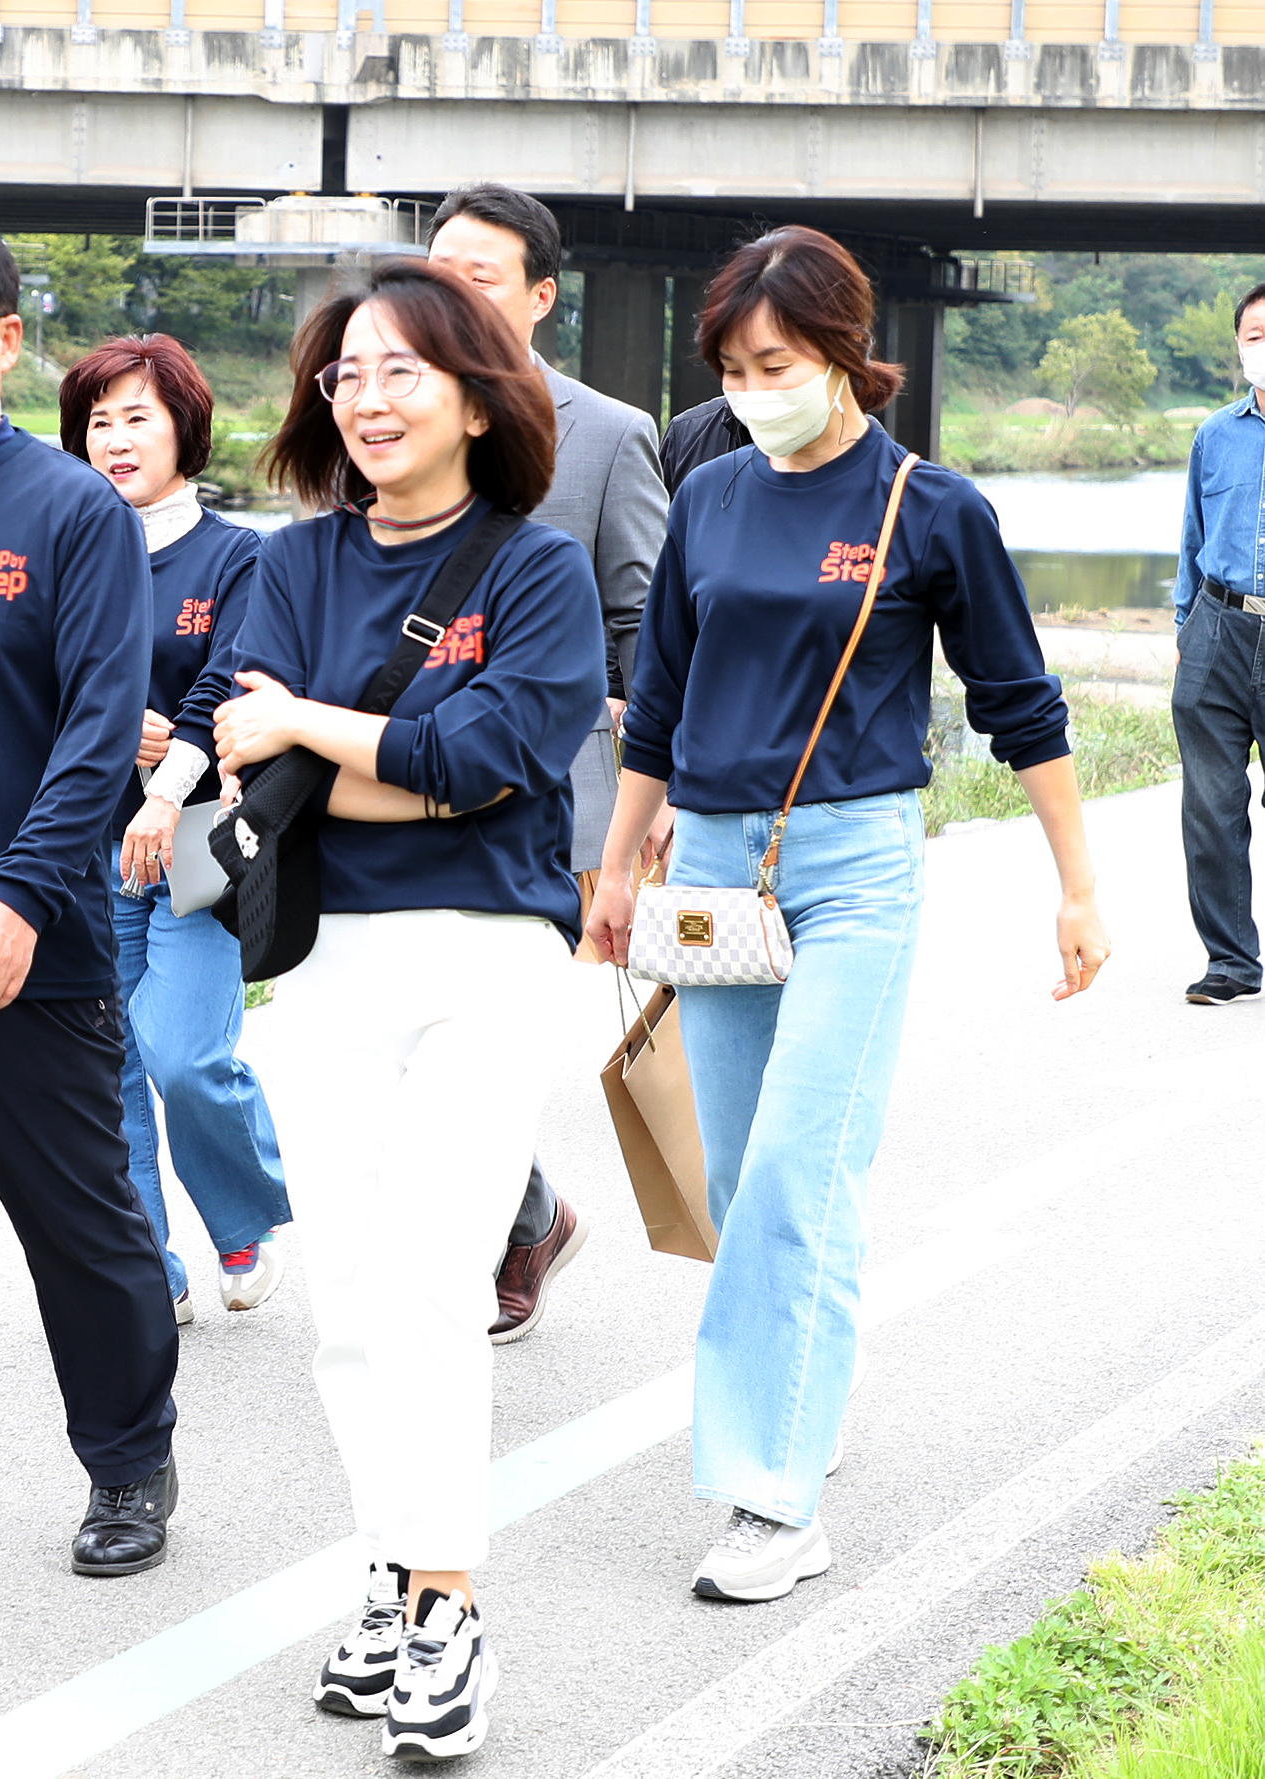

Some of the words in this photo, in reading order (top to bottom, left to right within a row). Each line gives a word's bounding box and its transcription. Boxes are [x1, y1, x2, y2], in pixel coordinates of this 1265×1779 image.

[827, 541, 871, 562] Step
[181, 598, 215, 613] Ste
[175, 612, 212, 635] Ste
